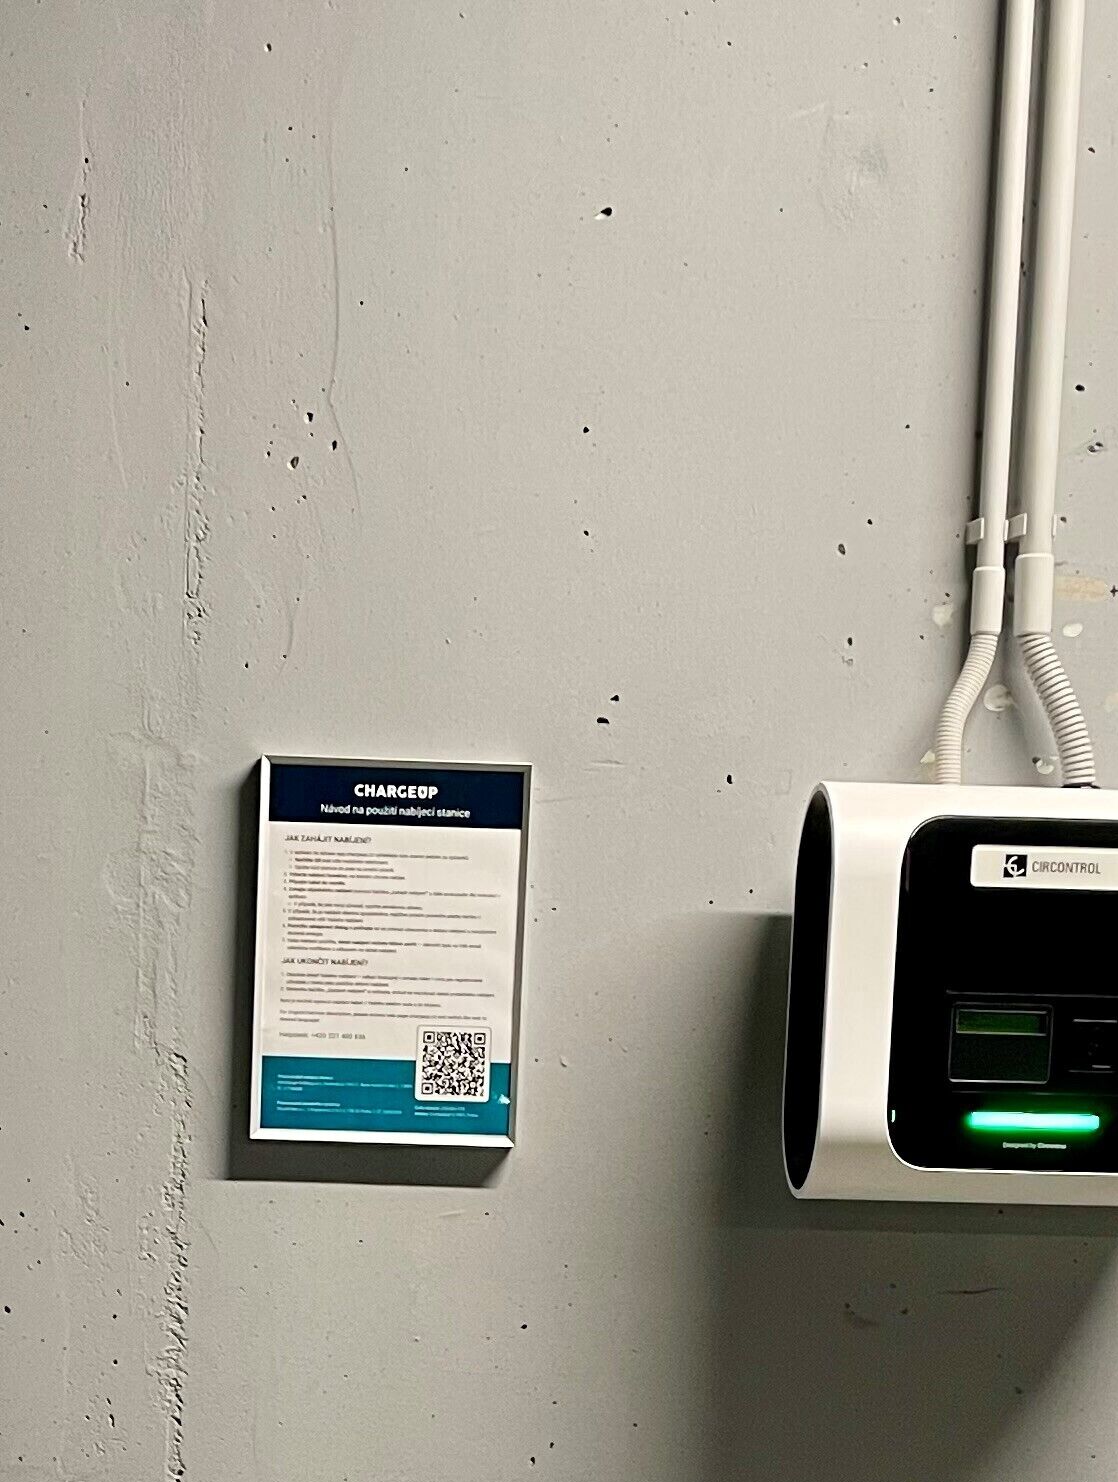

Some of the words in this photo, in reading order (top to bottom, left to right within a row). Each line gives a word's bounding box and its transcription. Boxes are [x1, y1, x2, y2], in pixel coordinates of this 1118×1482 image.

[354, 784, 439, 799] CHARGEUP
[320, 803, 350, 814] Návod
[352, 806, 364, 814] na
[436, 808, 471, 818] stanice
[1031, 860, 1101, 875] CIRCONTROL
